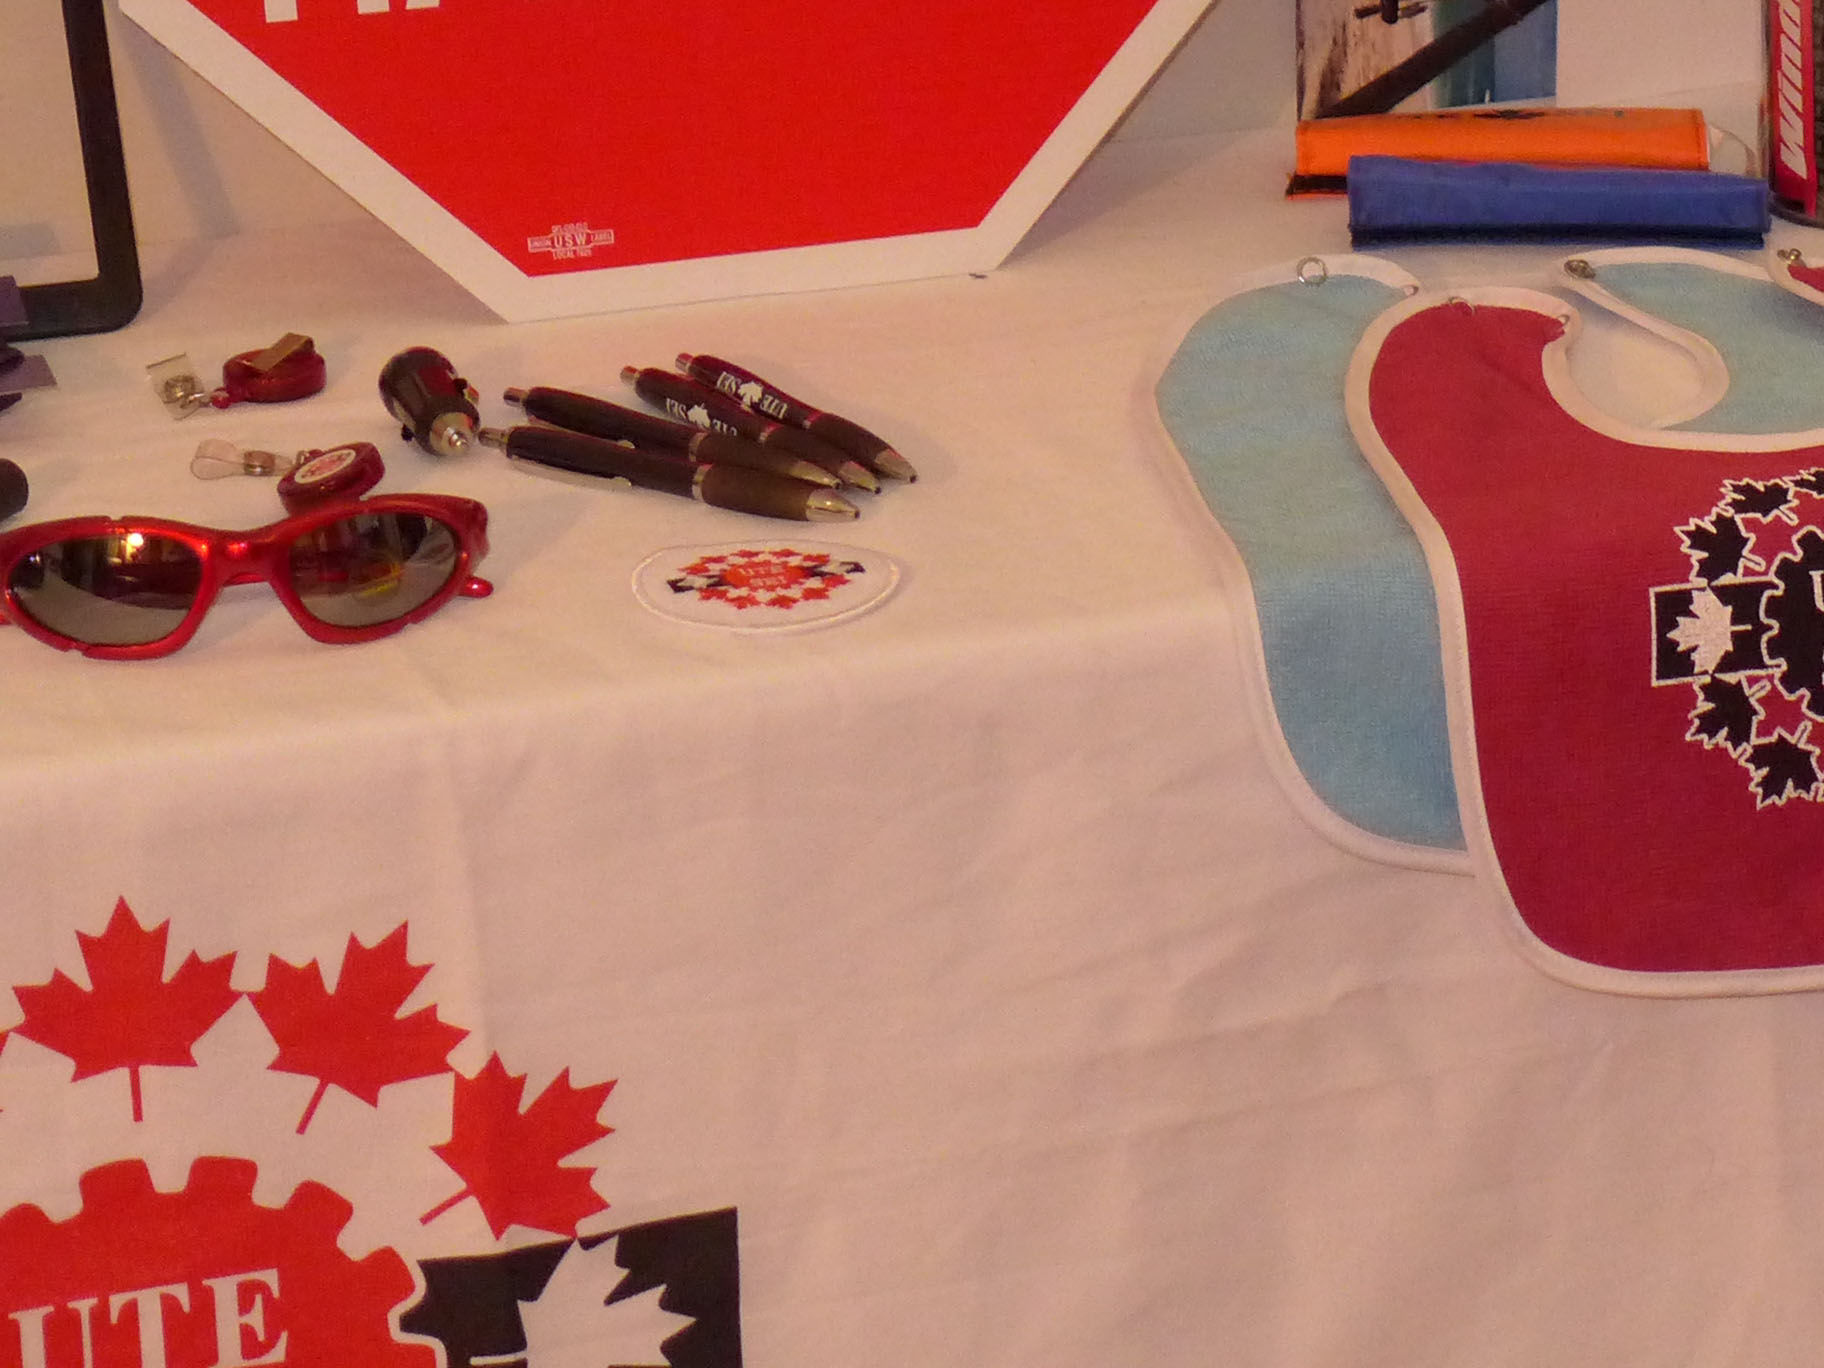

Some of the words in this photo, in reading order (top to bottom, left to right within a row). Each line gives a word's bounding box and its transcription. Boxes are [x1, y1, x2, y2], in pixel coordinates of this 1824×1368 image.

[715, 371, 740, 395] SEI
[759, 394, 788, 419] UTE
[8, 1268, 291, 1368] UTE
